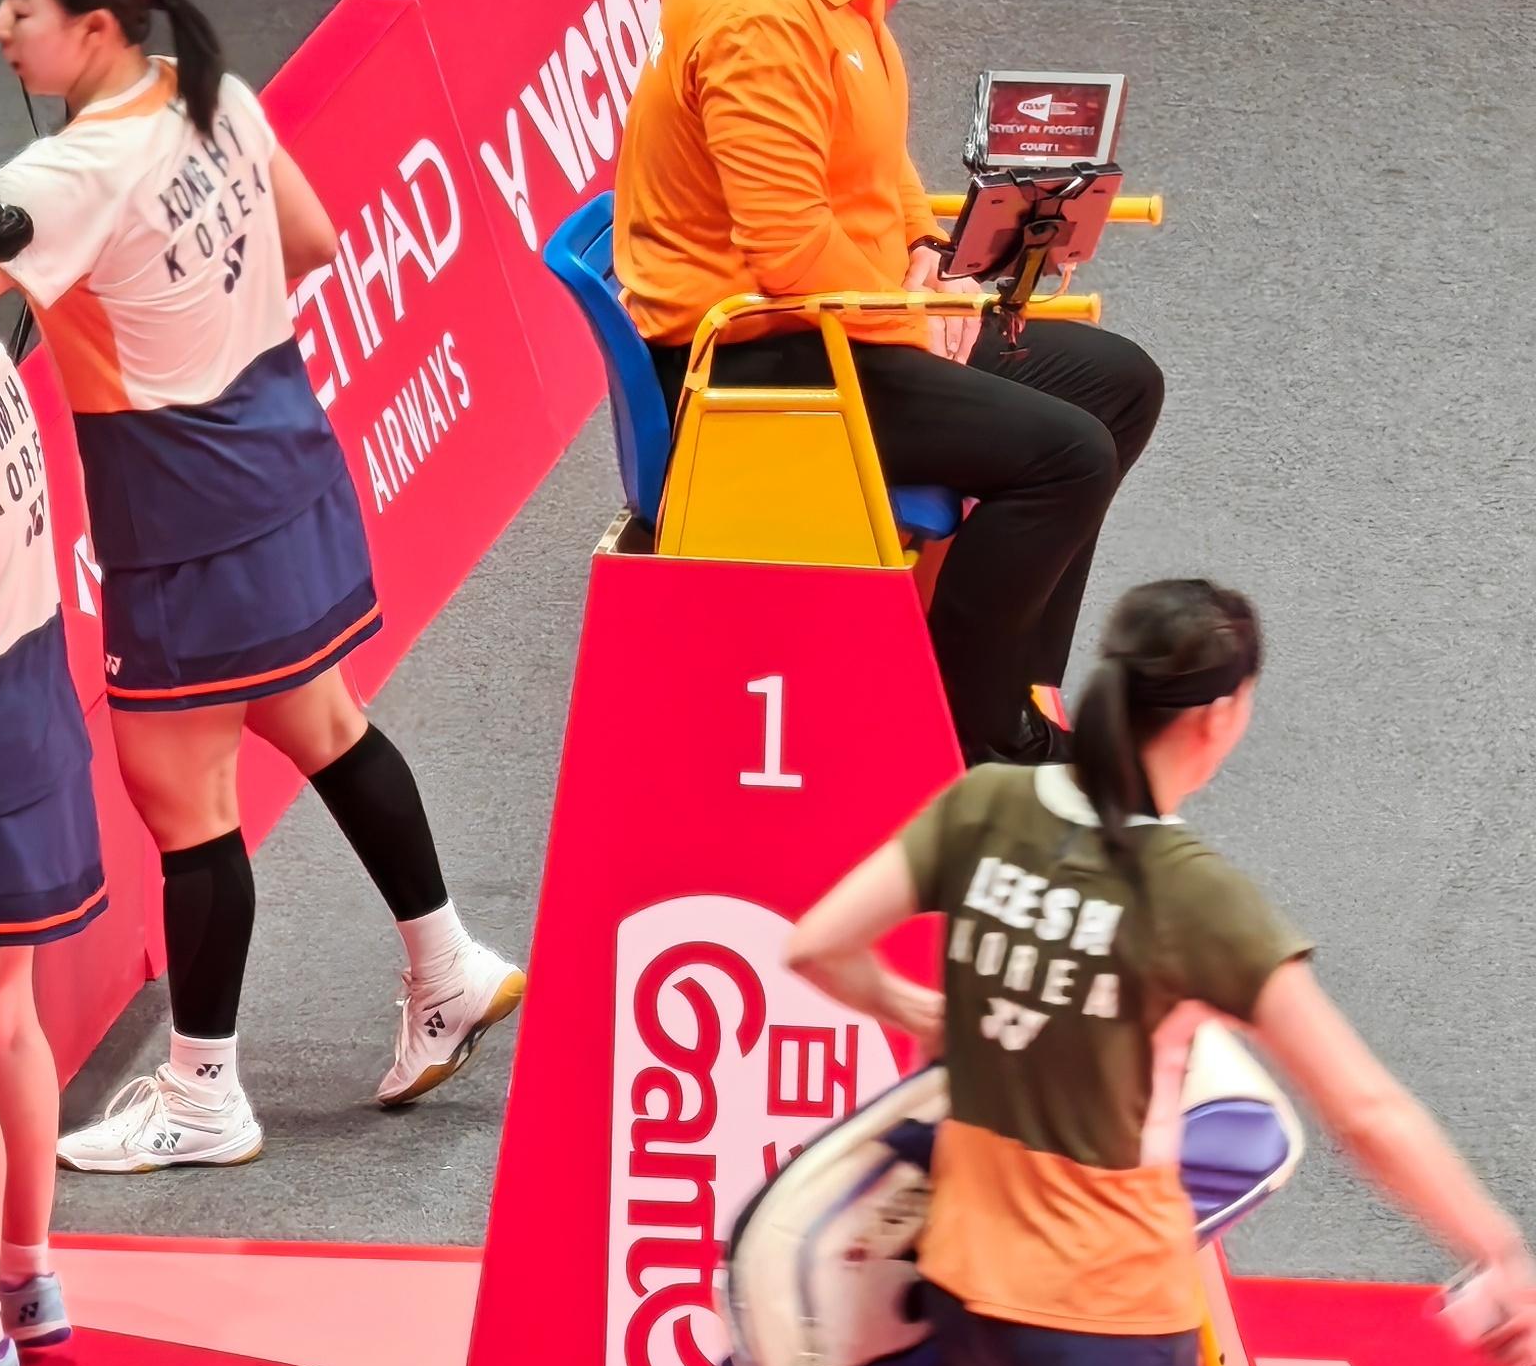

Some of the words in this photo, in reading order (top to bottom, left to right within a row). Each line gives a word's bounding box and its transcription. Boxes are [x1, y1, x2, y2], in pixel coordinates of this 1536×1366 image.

[1020, 142, 1052, 152] COURT
[164, 162, 266, 283] KOREA
[362, 331, 471, 515] AIRWAYS
[739, 675, 803, 787] 1
